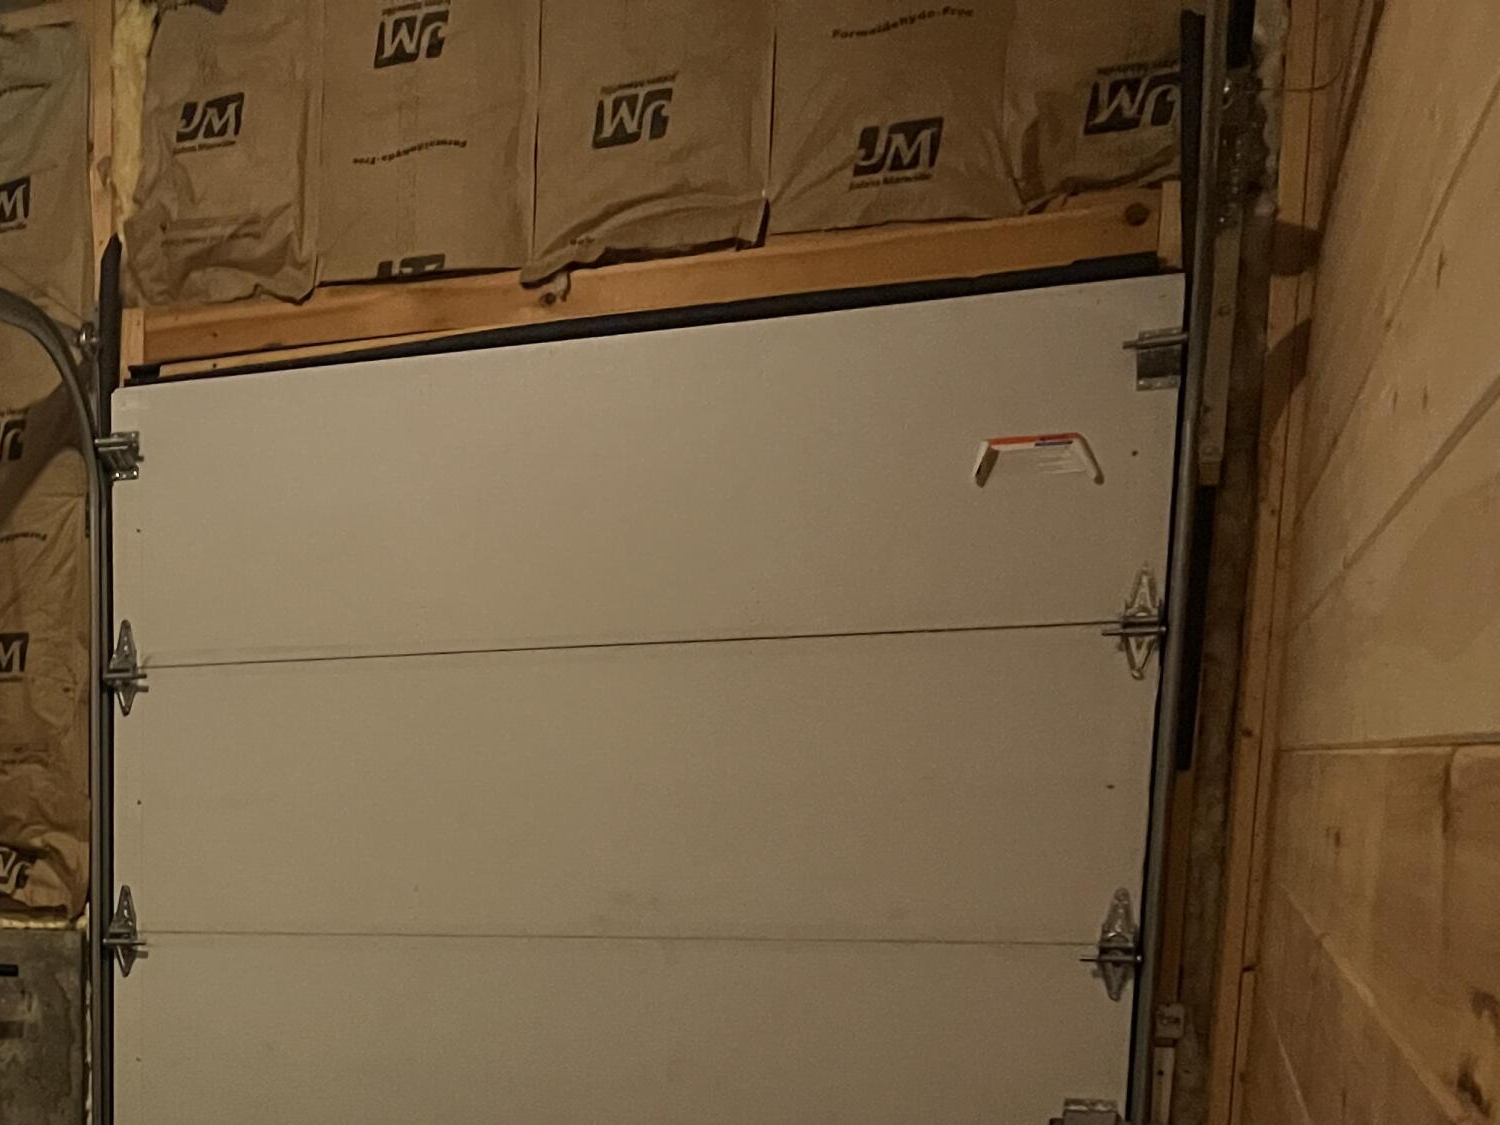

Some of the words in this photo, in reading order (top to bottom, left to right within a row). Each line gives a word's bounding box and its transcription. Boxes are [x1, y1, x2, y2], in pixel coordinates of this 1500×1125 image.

[374, 10, 449, 69] JM
[176, 92, 244, 143] JM
[592, 88, 672, 149] JM
[1083, 72, 1181, 136] JM
[853, 117, 944, 177] JM
